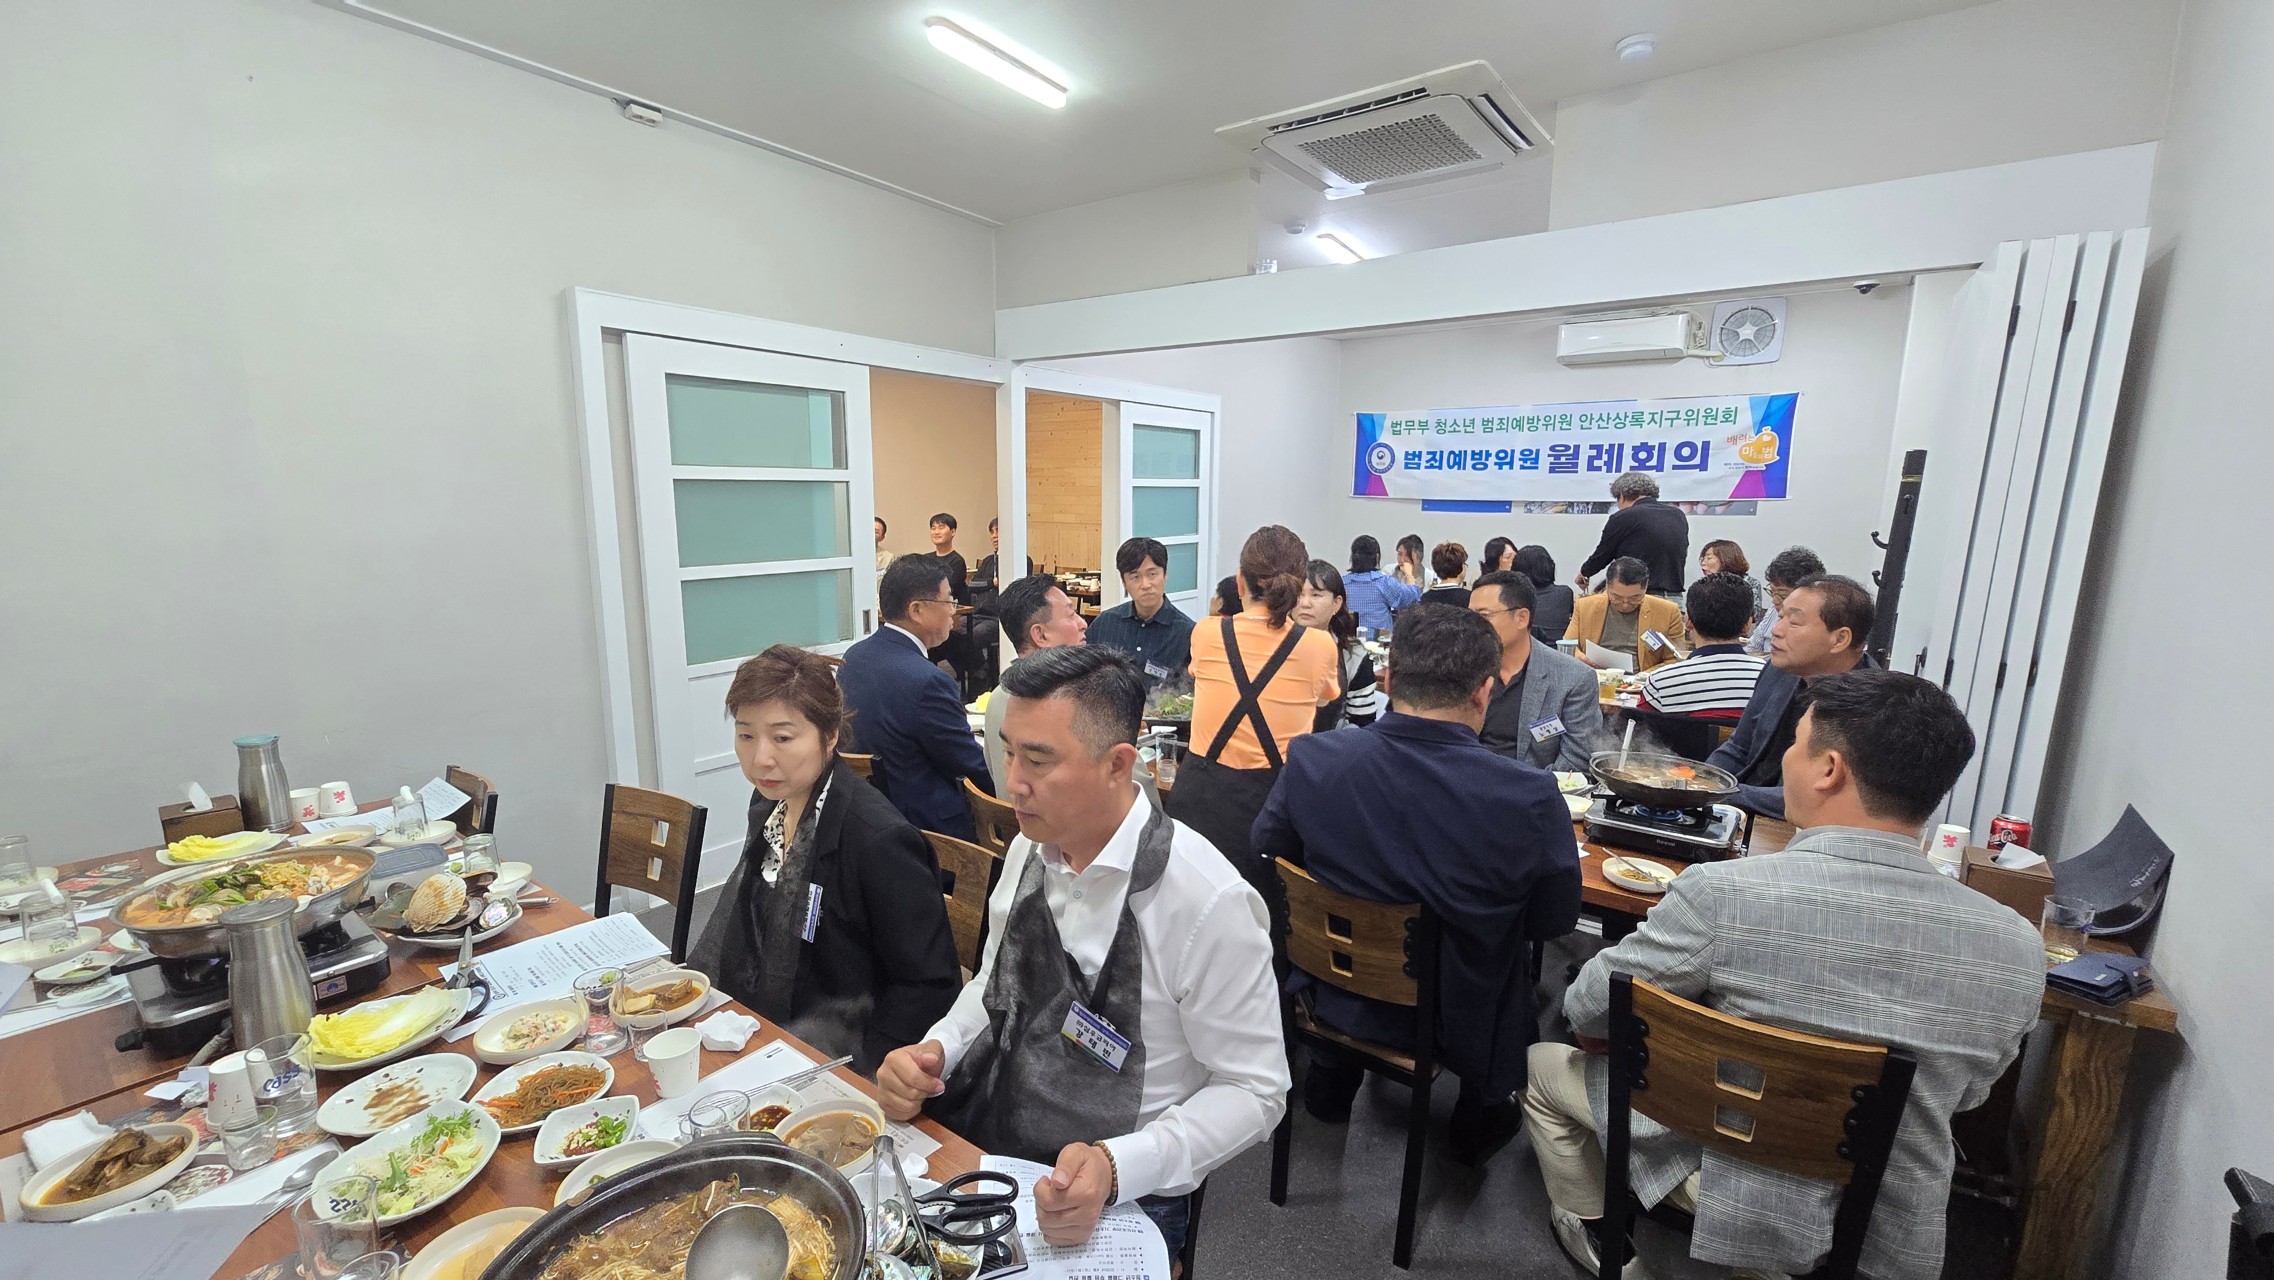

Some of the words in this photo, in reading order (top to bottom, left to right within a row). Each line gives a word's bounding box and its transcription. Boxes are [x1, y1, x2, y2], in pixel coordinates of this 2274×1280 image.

[1391, 418, 1430, 436] 법무부
[1434, 418, 1476, 435] 청소년
[1481, 413, 1573, 434] 범죄예방위원
[1578, 405, 1739, 431] 안산상록지구위원회
[1403, 448, 1541, 471] 범죄예방위원
[1547, 440, 1711, 474] 월례회의
